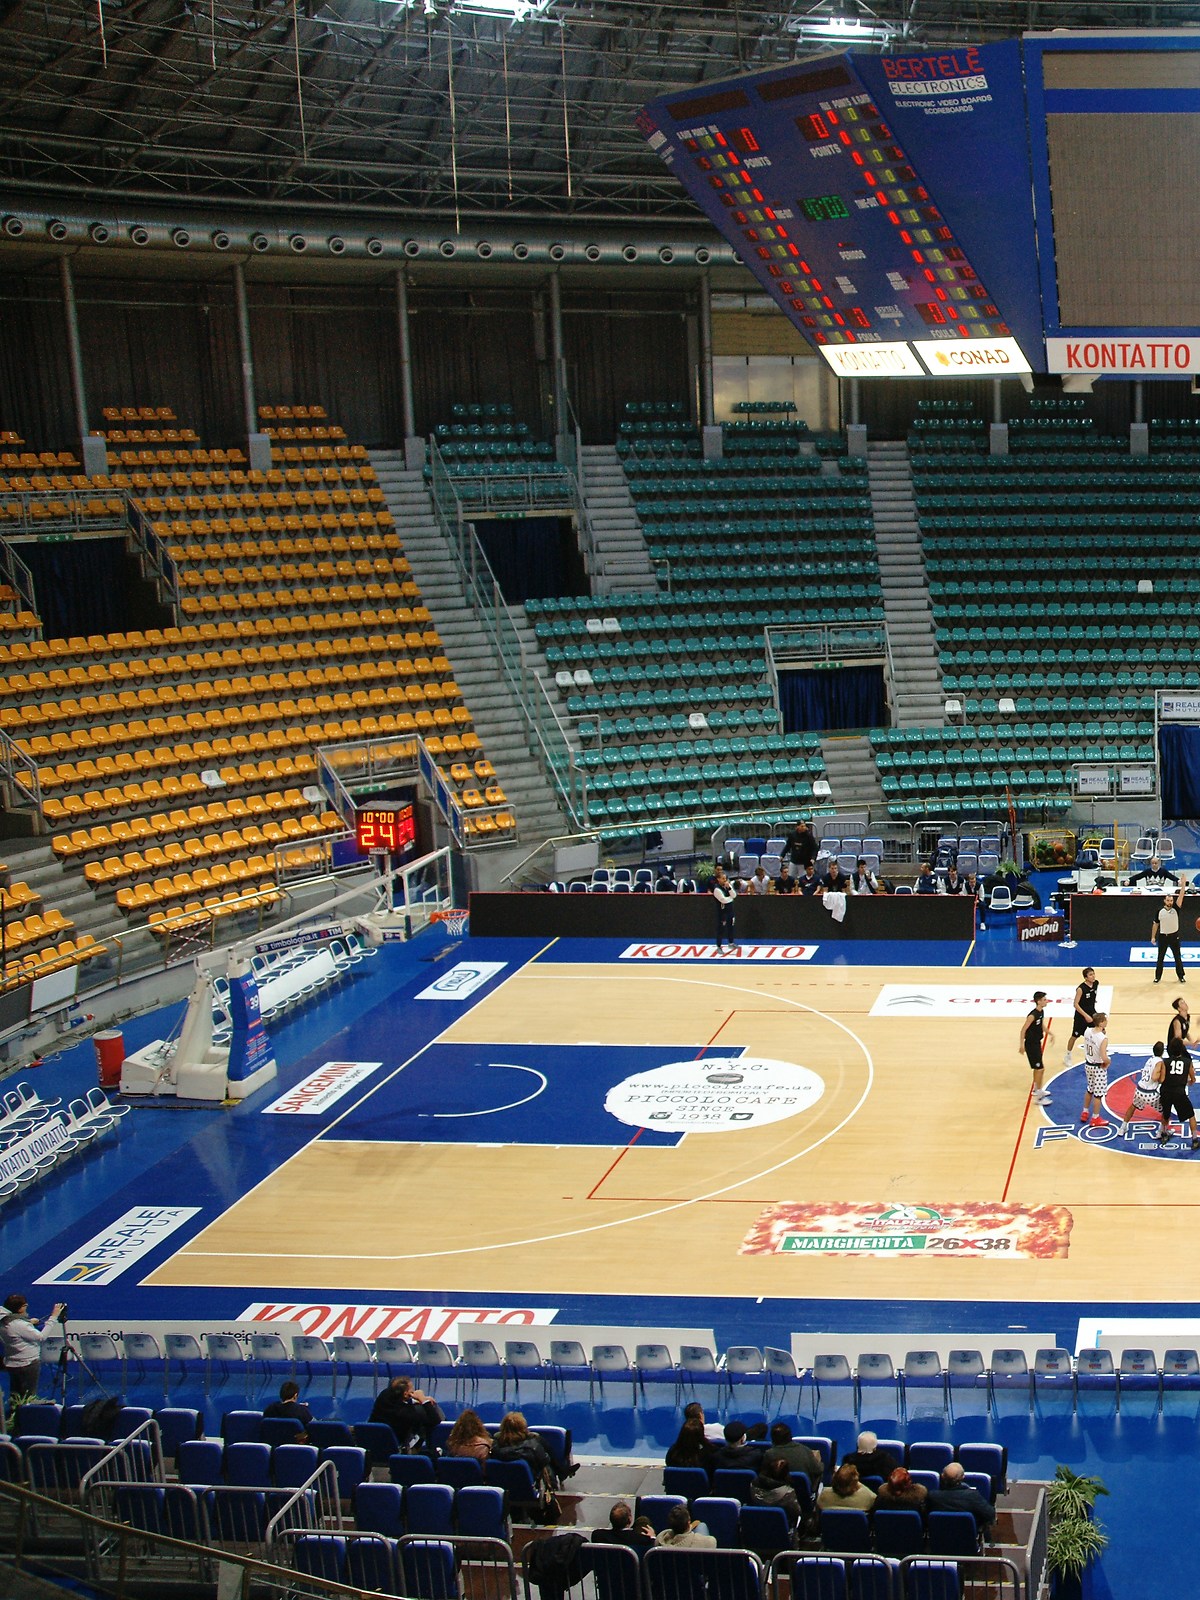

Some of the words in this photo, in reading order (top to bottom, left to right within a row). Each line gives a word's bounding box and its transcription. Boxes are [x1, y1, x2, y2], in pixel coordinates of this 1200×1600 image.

[889, 76, 987, 94] ELECTRONICS
[937, 98, 959, 106] VIDEO
[809, 144, 842, 158] POINTS
[950, 350, 1010, 365] CONAD
[1066, 343, 1191, 368] KONTATTO
[361, 826, 394, 846] 24
[270, 934, 318, 950] timbologna.it
[630, 945, 806, 958] KONTATTO
[1170, 1060, 1184, 1075] 19
[274, 1064, 357, 1112] SANGEMINI
[28, 1123, 69, 1160] KONTATTO
[84, 1210, 165, 1258] REALE
[111, 1210, 184, 1259] MUTUA
[792, 1238, 914, 1250] MARGHERITA
